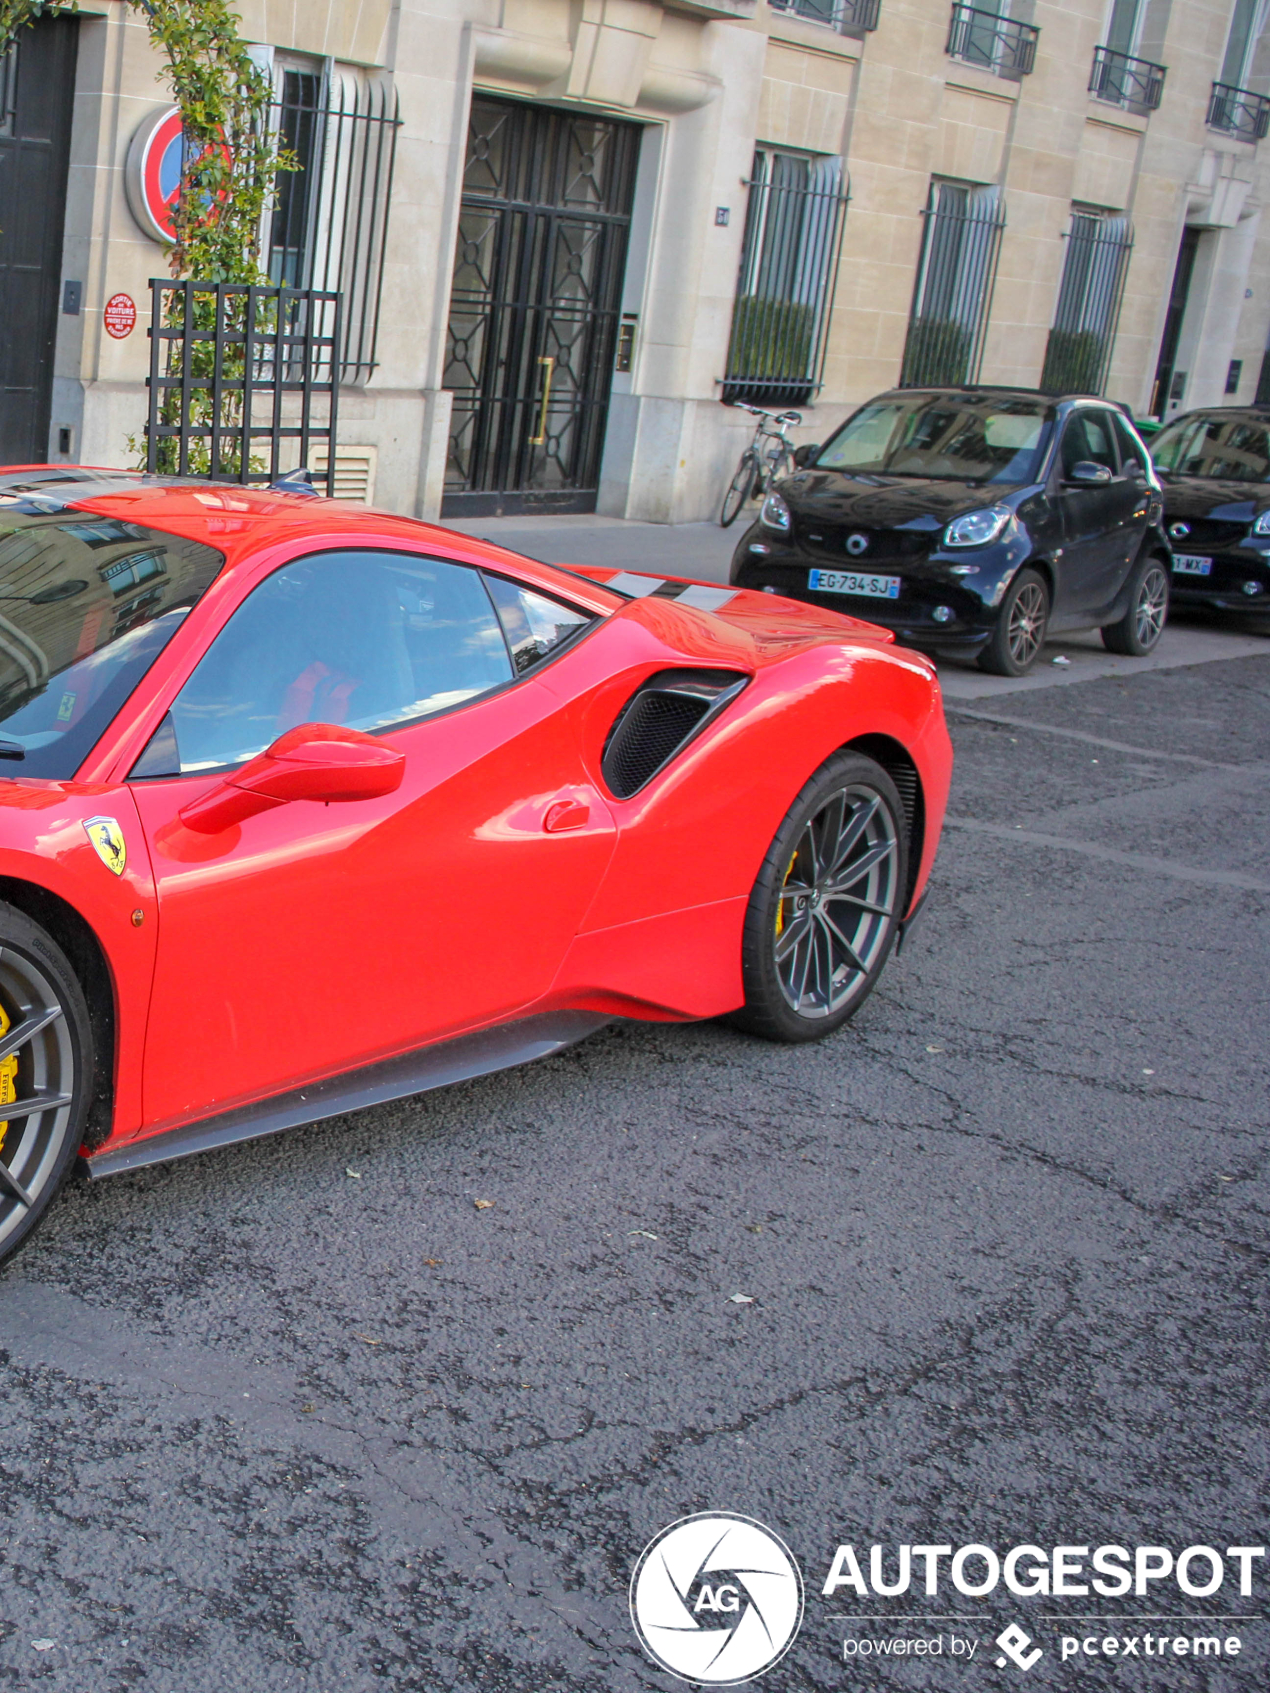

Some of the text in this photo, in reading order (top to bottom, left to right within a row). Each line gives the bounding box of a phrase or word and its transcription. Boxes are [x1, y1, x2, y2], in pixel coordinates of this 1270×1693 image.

[111, 295, 132, 307] SORTIE
[107, 307, 134, 315] VOITURE
[818, 572, 889, 594] EG-734-SJ
